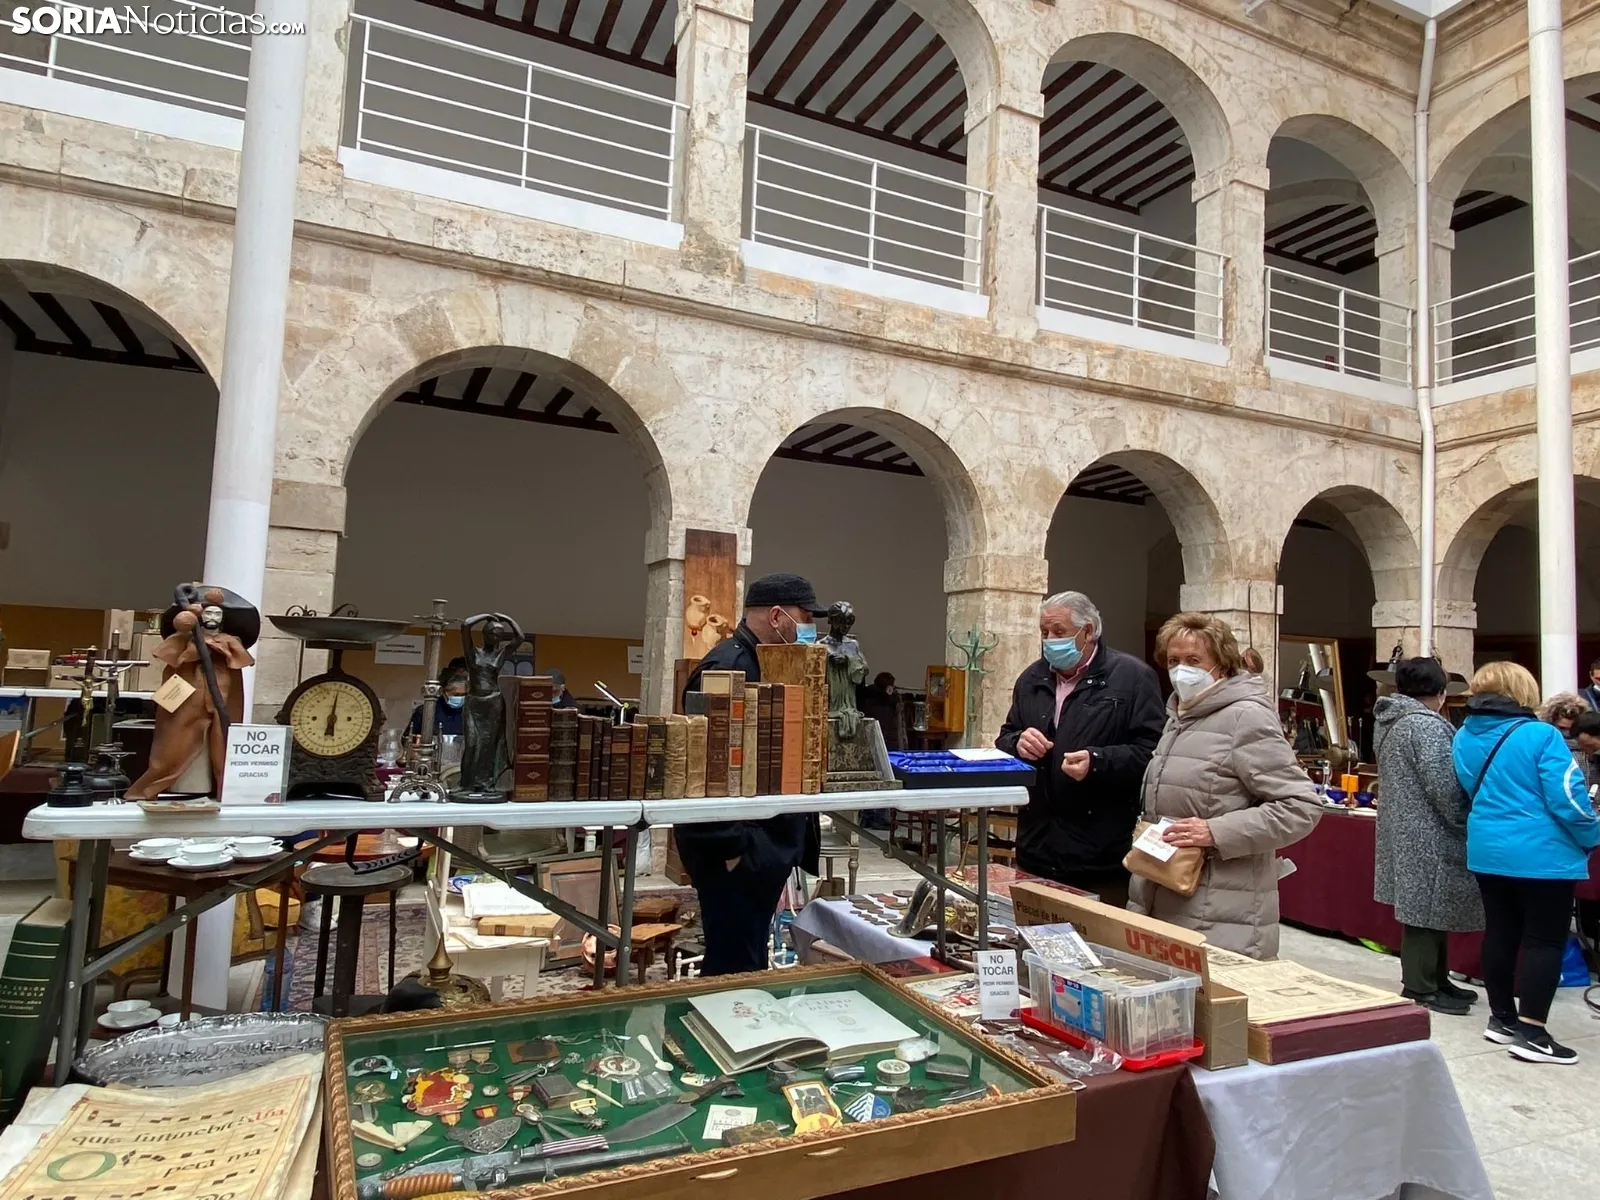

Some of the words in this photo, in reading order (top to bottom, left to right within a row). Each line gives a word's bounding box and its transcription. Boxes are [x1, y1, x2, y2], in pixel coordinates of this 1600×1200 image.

[246, 731, 268, 741] NO
[232, 744, 280, 754] TOCAR
[1124, 928, 1201, 972] UTSCH
[989, 954, 1004, 964] NO
[982, 966, 1014, 976] TOCAR
